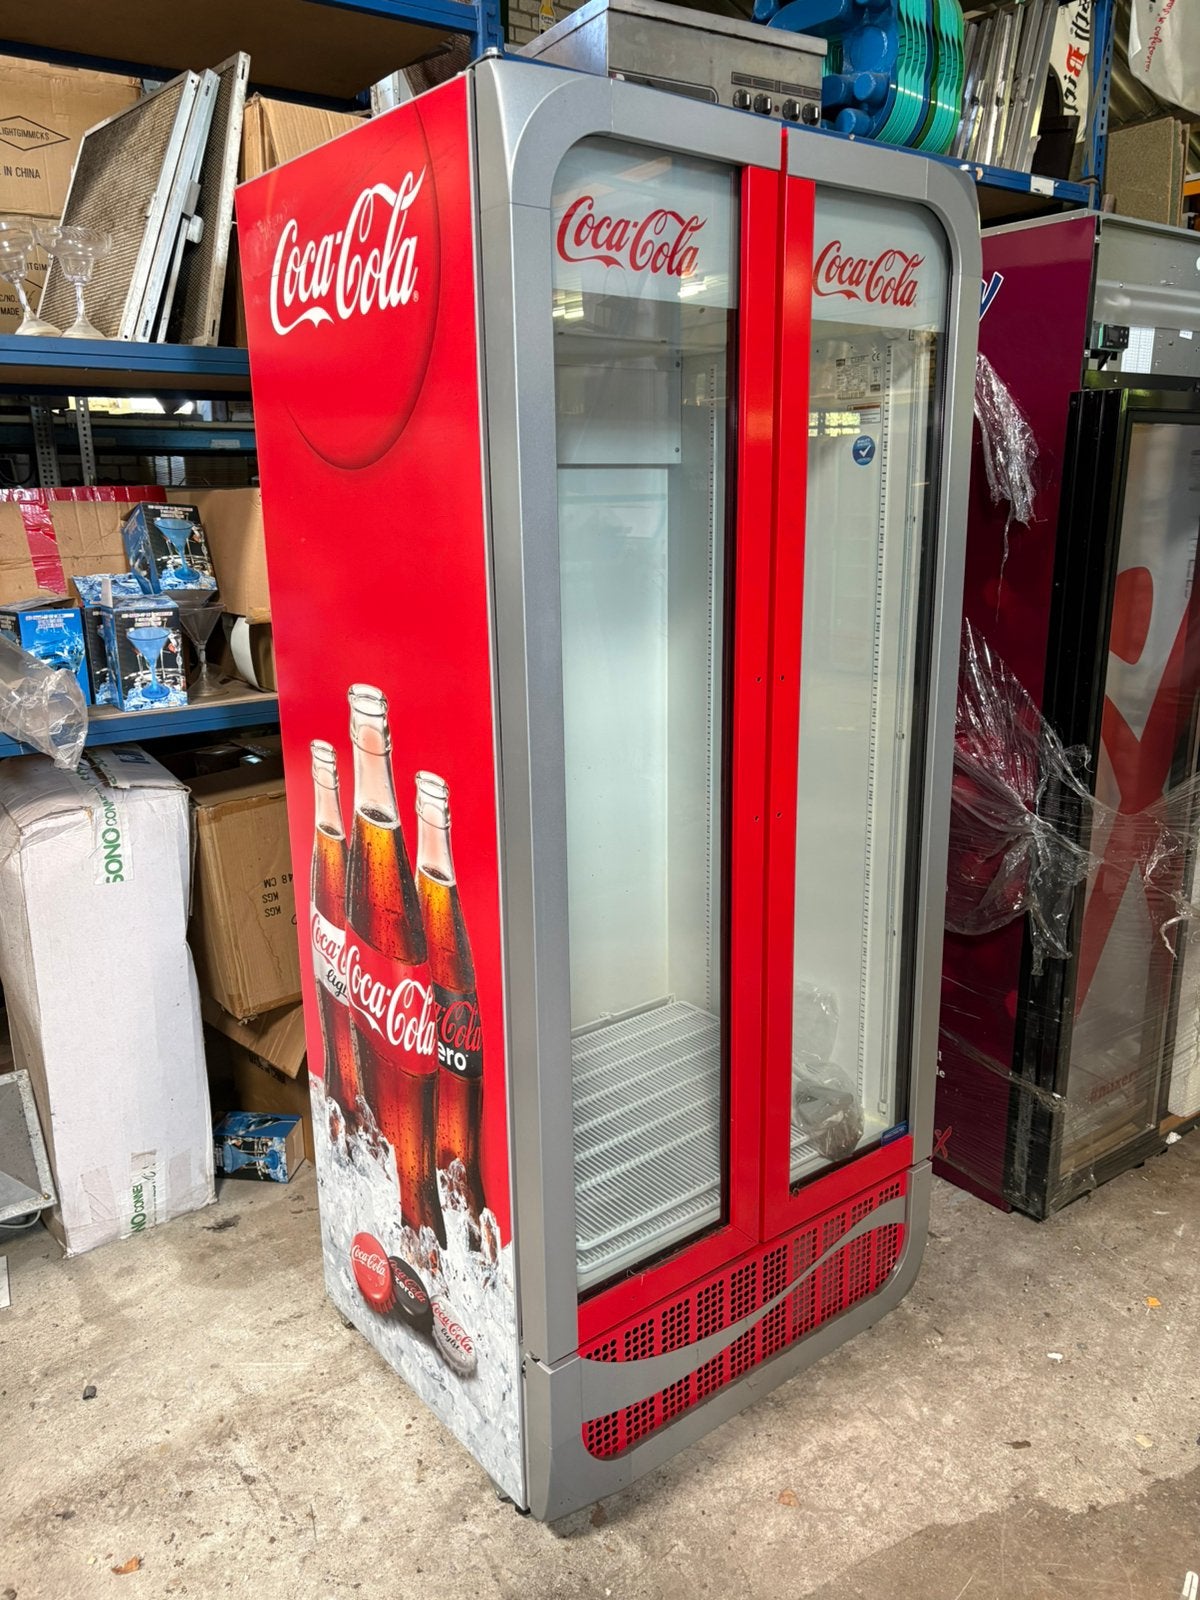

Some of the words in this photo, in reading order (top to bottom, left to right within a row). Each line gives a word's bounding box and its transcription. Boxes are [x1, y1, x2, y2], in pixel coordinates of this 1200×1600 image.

[0, 126, 50, 141] IGHTGIMMICKS
[3, 165, 13, 177] IN
[15, 166, 41, 179] CHINA
[270, 163, 427, 336] Coca-Cola
[556, 195, 708, 277] Coca-Cola
[812, 240, 926, 307] Coca-Cola
[0, 307, 20, 316] MADE
[261, 891, 279, 904] KGS
[263, 877, 277, 889] CM
[264, 905, 282, 918] KGS
[346, 945, 436, 1057] Coca-Cola
[437, 1040, 468, 1072] ero
[351, 1244, 388, 1276] Coca-Cola
[430, 1302, 474, 1355] Coca-Cola
